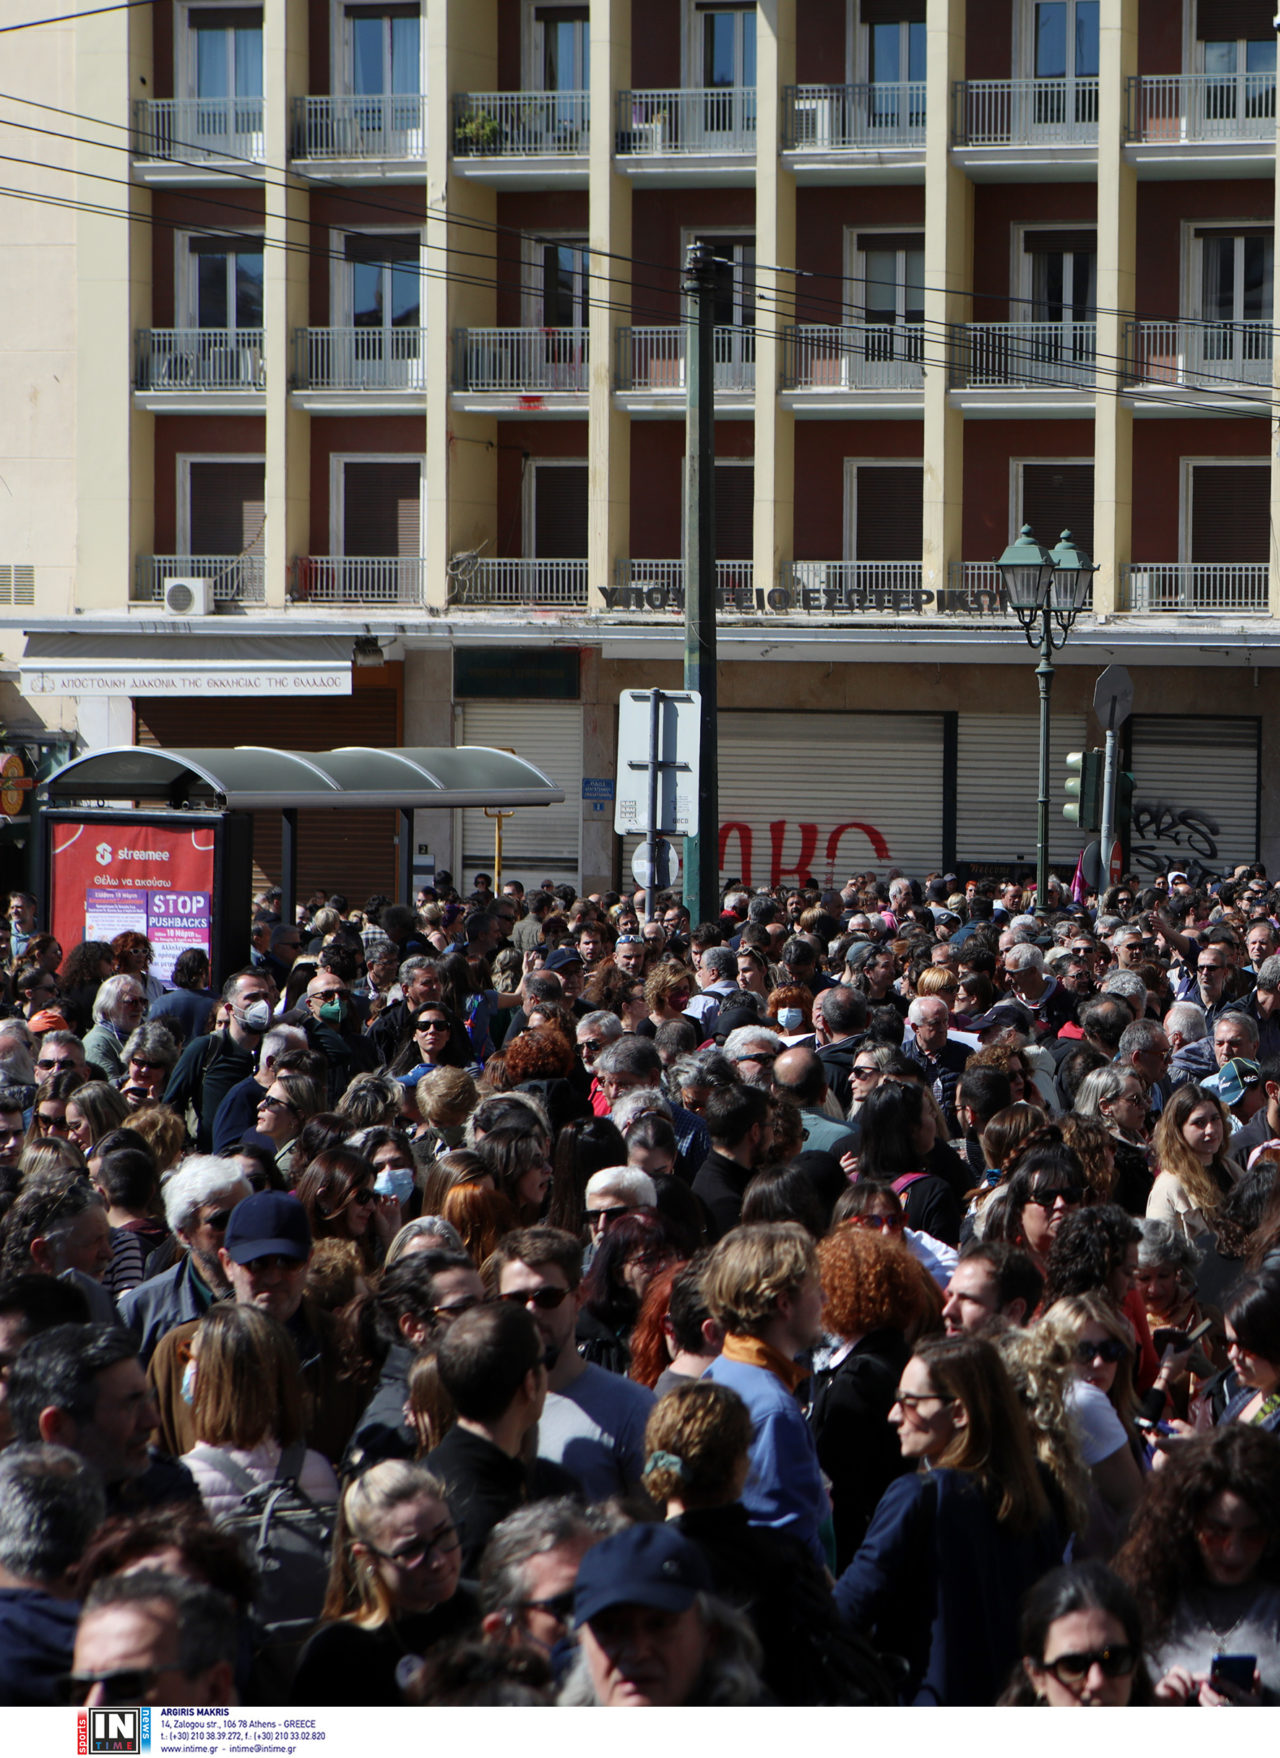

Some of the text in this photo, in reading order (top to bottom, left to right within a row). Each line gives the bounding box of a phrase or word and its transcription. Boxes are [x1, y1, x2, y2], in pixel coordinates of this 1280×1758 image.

[598, 586, 792, 611] ΥΠΟΥΓΕΙΟ
[118, 847, 170, 862] streamee
[93, 874, 172, 888] Θέλω να ακούσω
[153, 894, 205, 914] STOP
[148, 916, 208, 928] PUSHBACKS
